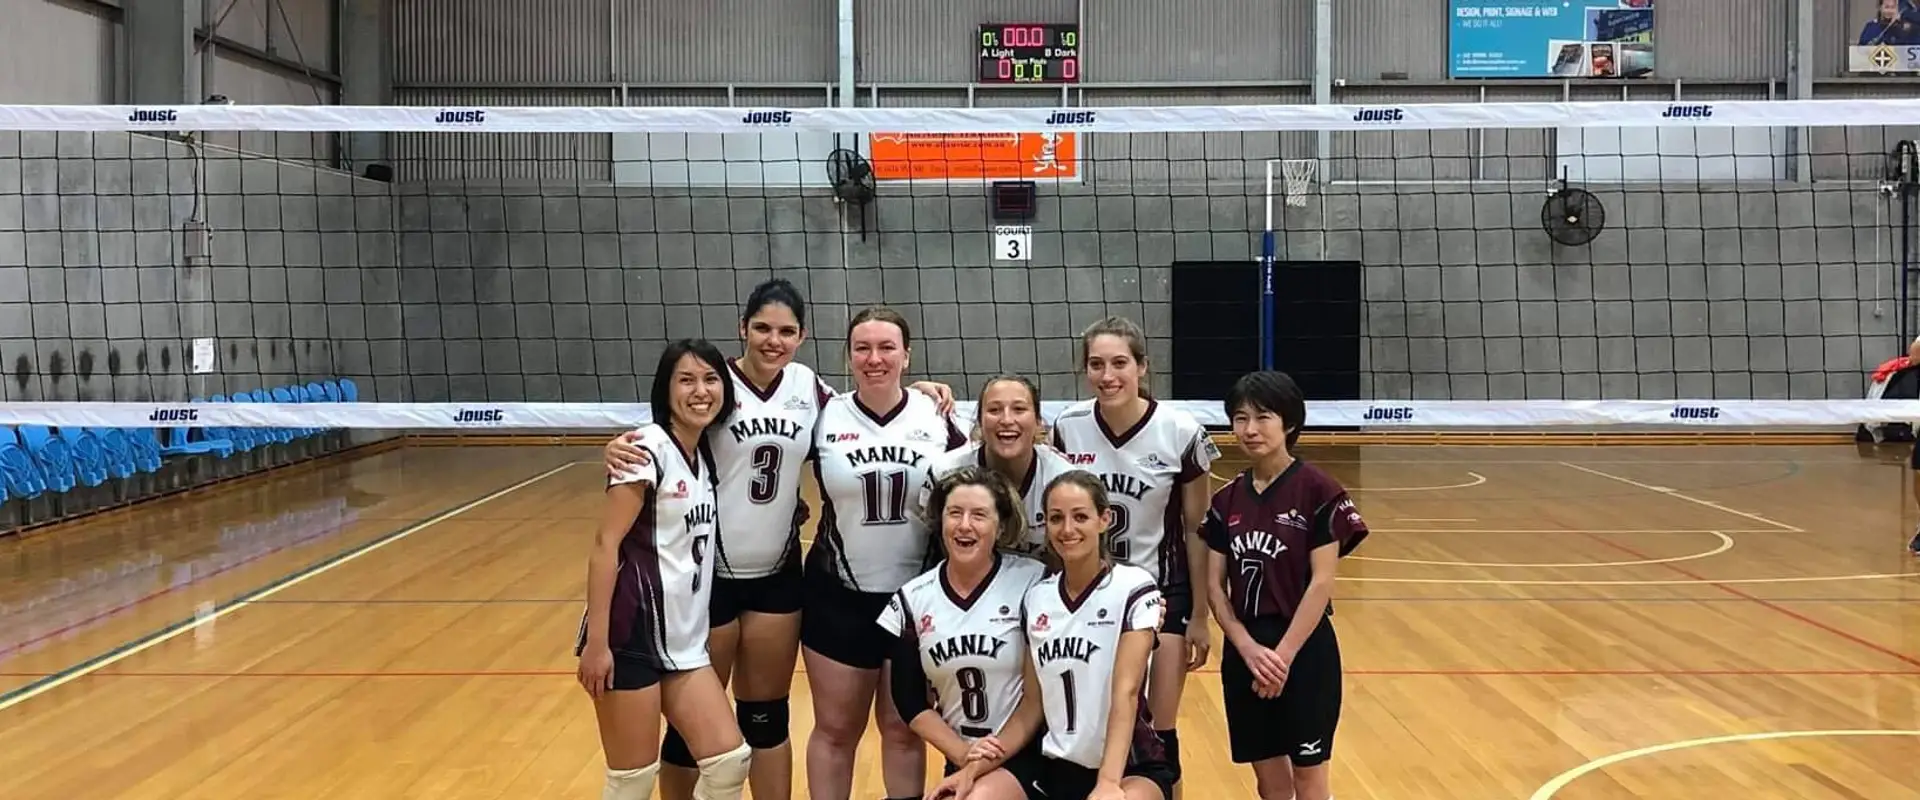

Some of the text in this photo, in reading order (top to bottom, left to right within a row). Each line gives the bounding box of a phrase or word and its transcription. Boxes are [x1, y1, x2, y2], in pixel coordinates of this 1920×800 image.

[1505, 7, 1533, 17] SIGNAGE
[1542, 7, 1558, 17] WEB
[1004, 27, 1043, 46] 00.0
[982, 49, 1015, 59] A Light
[1045, 49, 1076, 57] B Dark
[1907, 47, 1920, 61] S
[999, 59, 1011, 78] 0
[1015, 64, 1043, 78] 0 0
[1063, 59, 1075, 78] 0
[997, 227, 1031, 235] COURT
[1008, 239, 1020, 259] 3
[730, 417, 804, 444] MANLY
[845, 446, 925, 468] MANLY
[749, 443, 784, 504] 3
[858, 469, 908, 526] 11
[1100, 473, 1153, 501] ANLY
[1107, 502, 1129, 562] 2
[1230, 530, 1289, 561] MANLY
[1241, 558, 1264, 618] 7
[928, 634, 1007, 667] MANLY
[1038, 636, 1102, 668] MANLY
[956, 666, 989, 723] 8
[1060, 668, 1077, 735] 1
